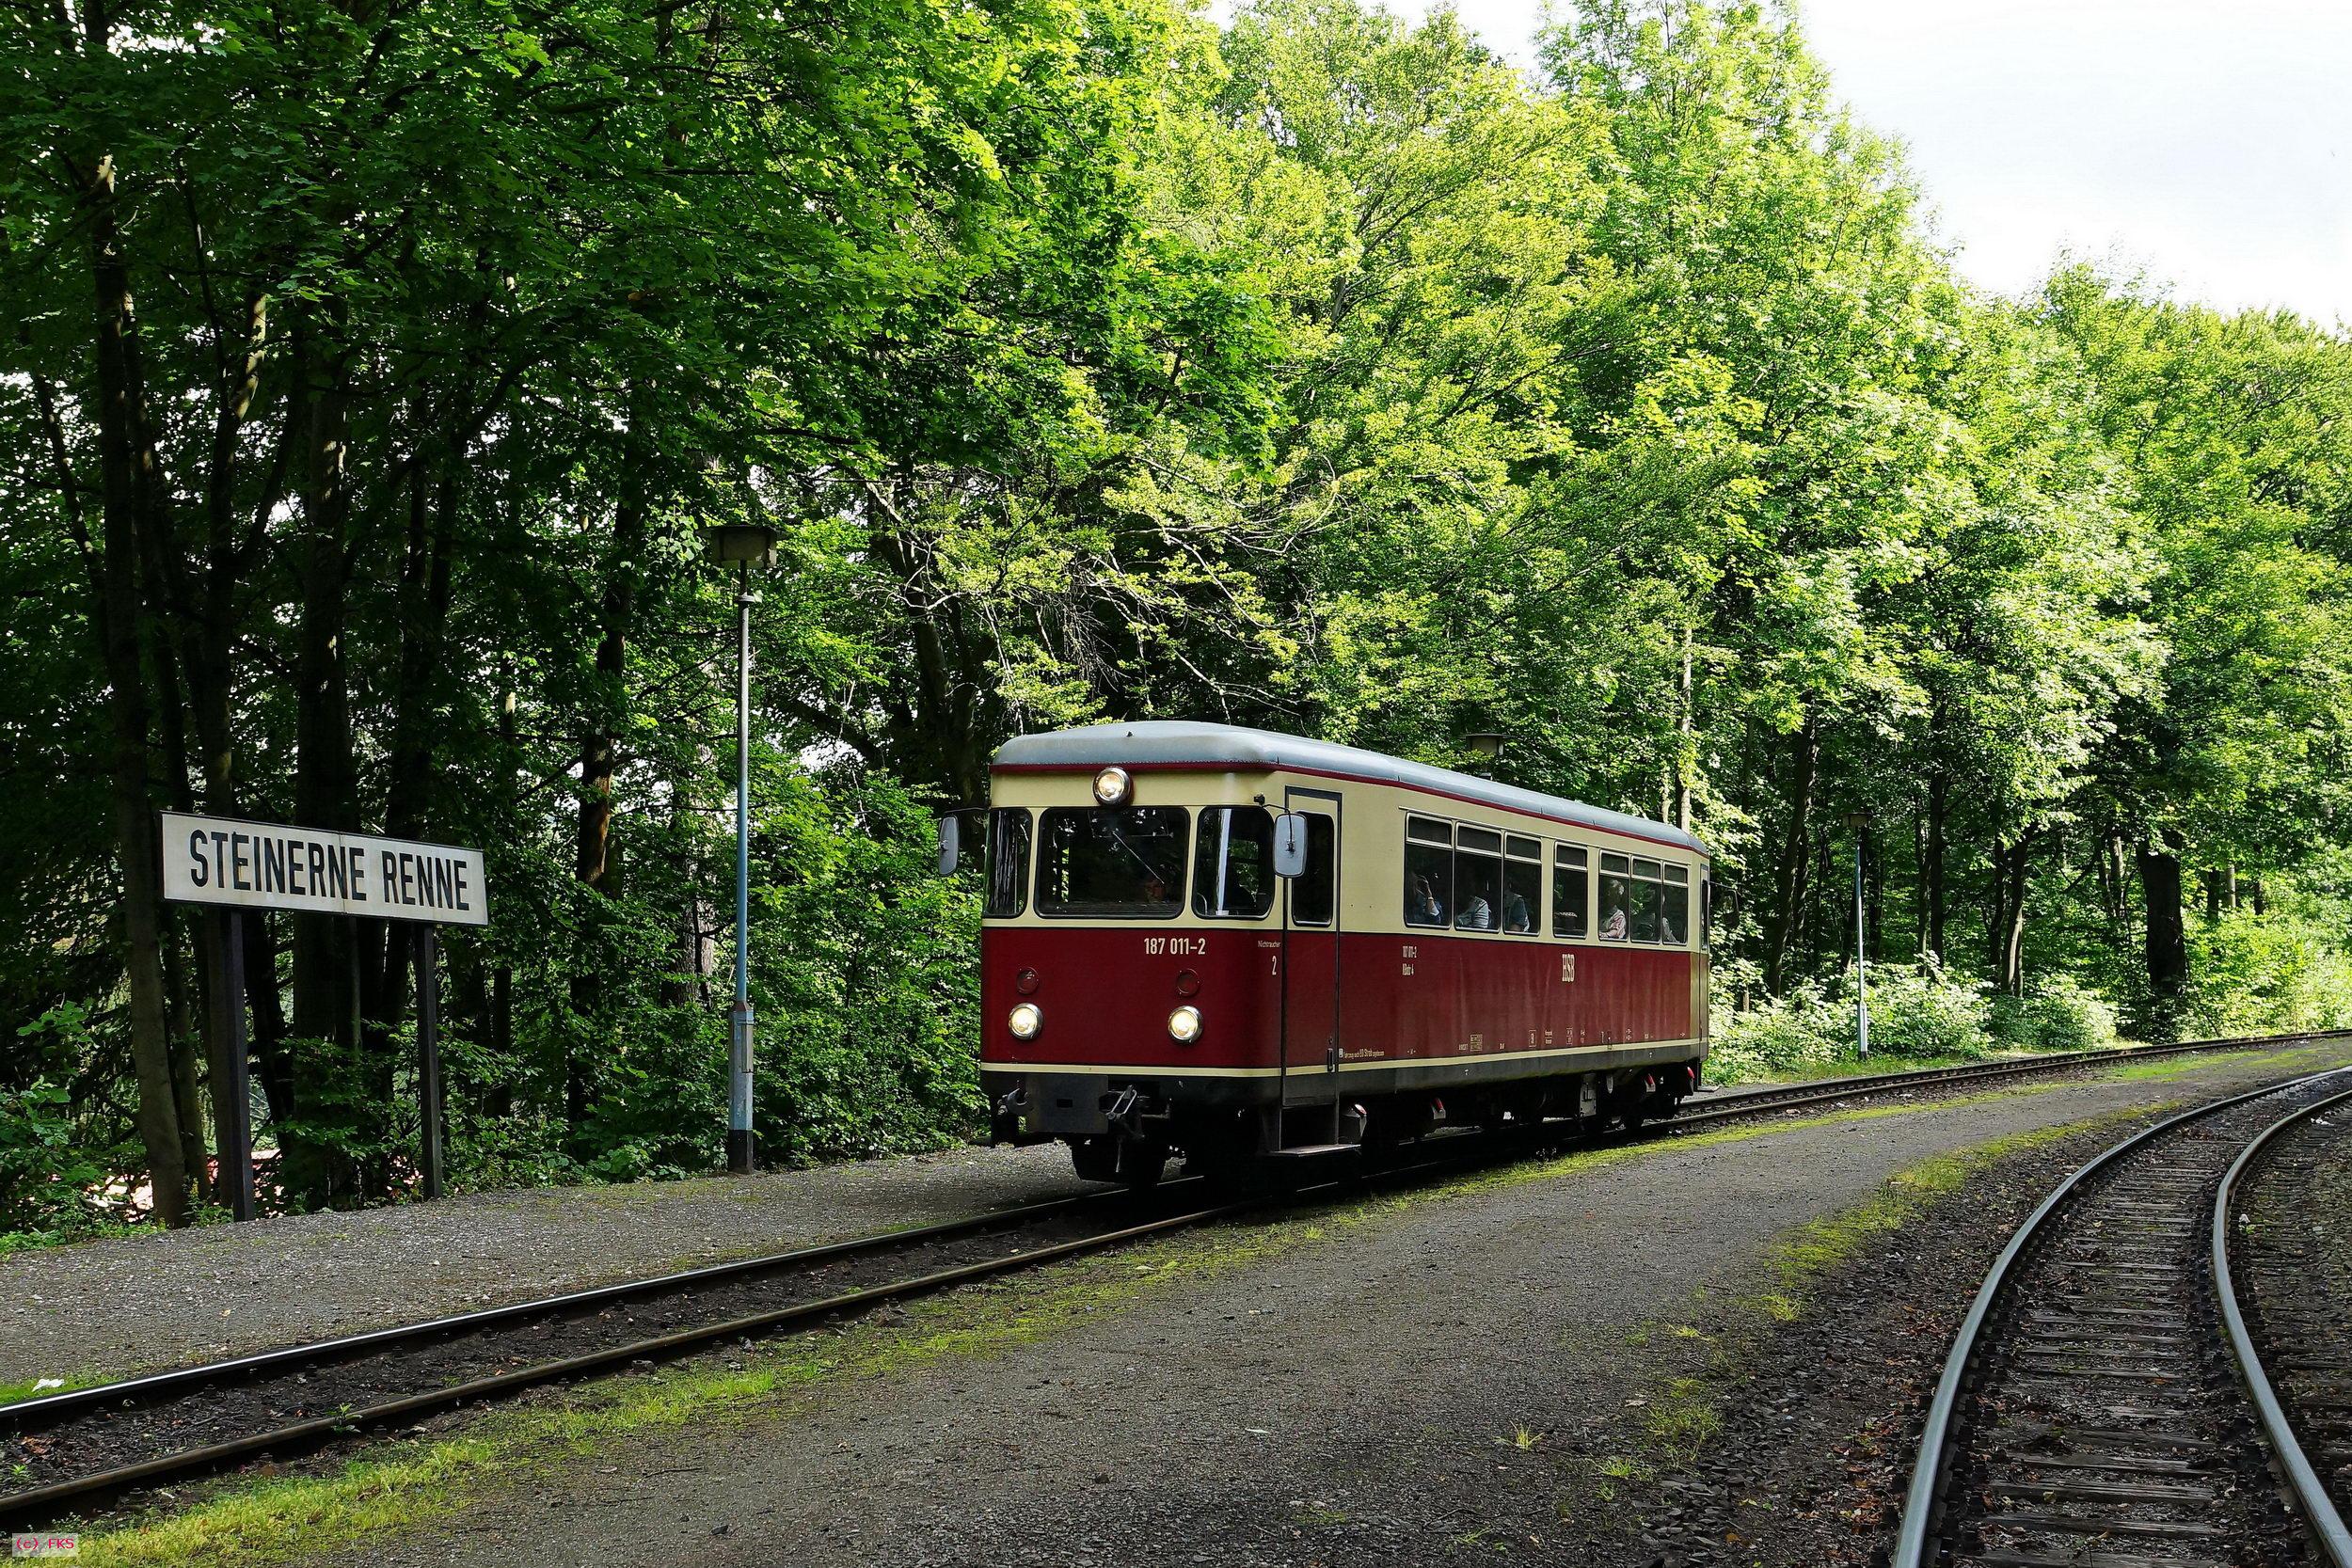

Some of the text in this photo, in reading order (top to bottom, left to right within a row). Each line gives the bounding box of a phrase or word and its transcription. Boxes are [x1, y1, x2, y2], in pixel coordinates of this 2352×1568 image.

[189, 829, 469, 911] STEINERNE RENNE
[1144, 938, 1206, 955] 187 011-2
[1271, 955, 1278, 975] 2
[1562, 954, 1575, 982] HSB
